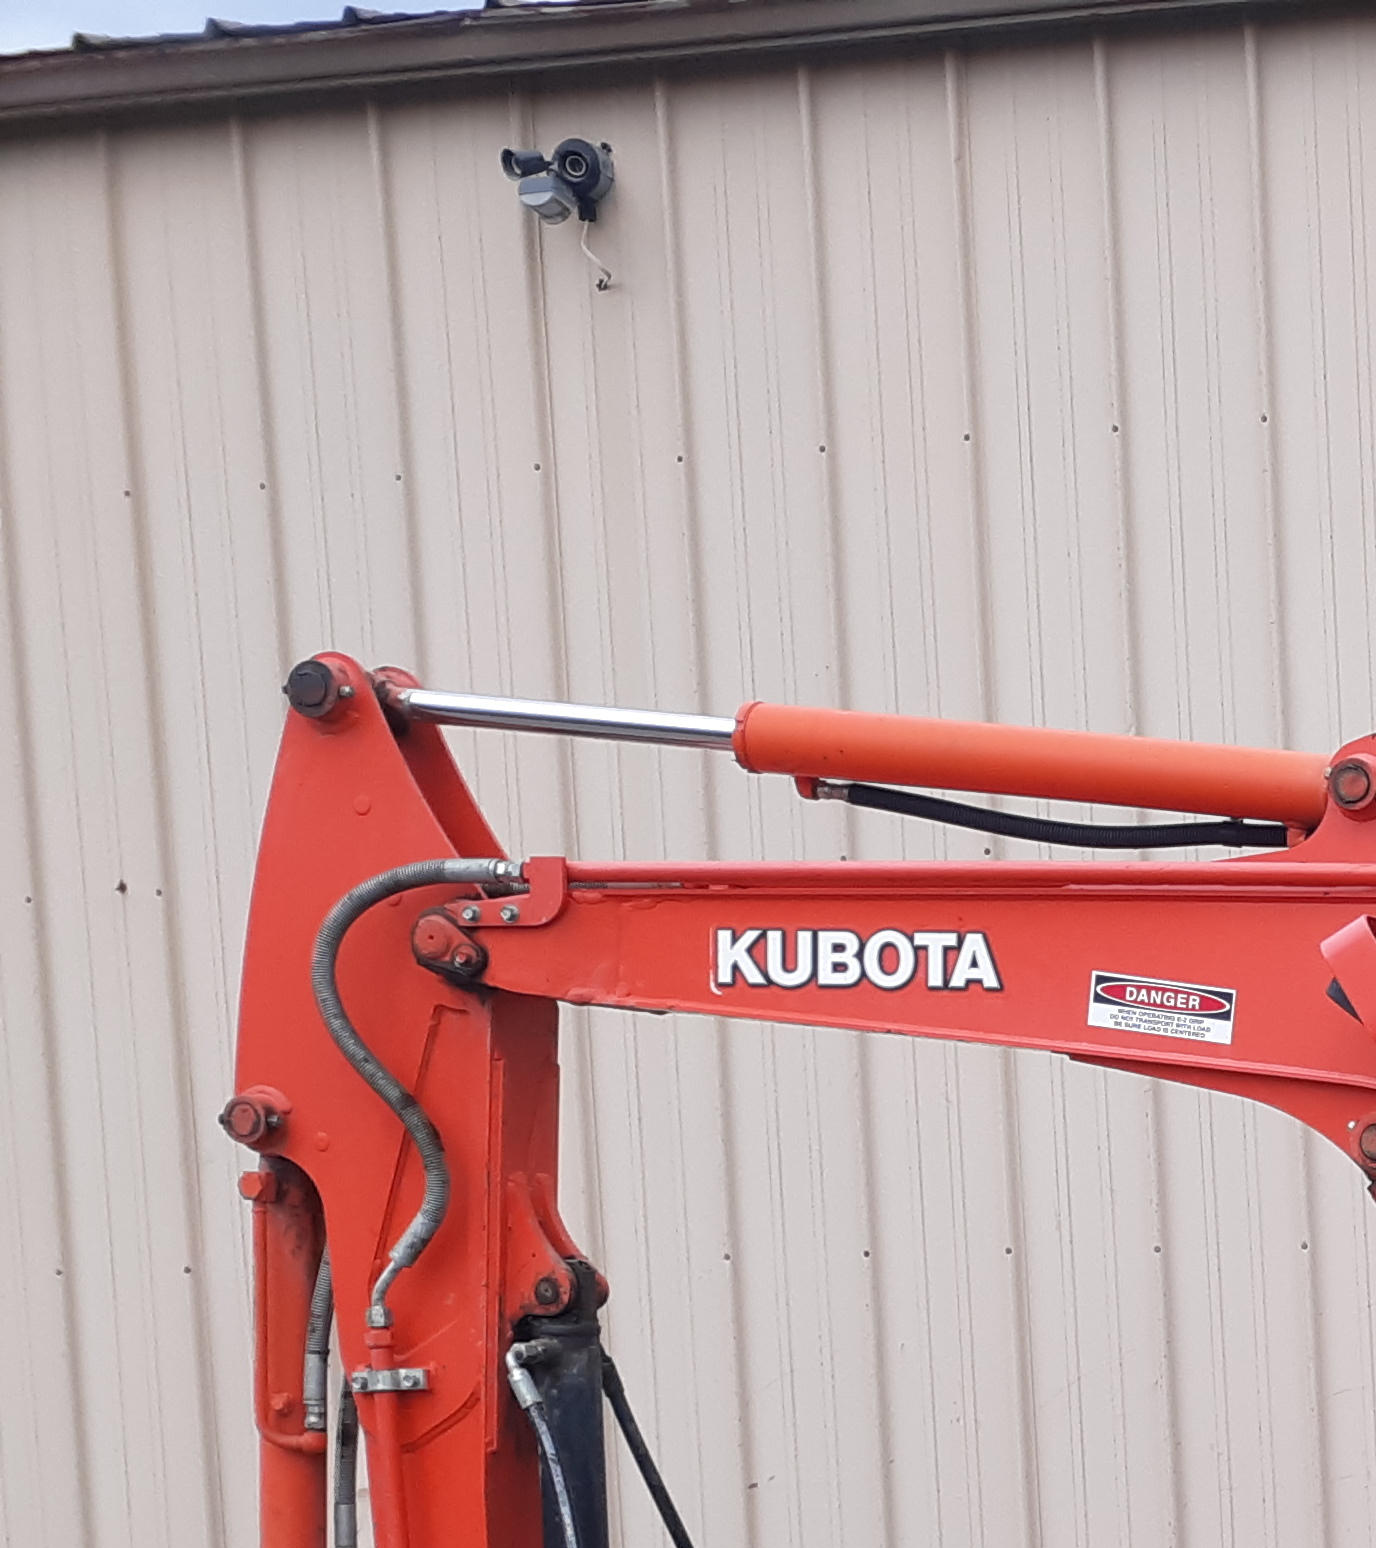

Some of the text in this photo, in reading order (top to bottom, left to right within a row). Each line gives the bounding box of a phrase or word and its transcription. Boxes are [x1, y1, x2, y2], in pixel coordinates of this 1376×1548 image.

[716, 929, 1003, 990] KUBOTA
[1125, 986, 1200, 1010] DANGER
[1135, 1016, 1174, 1028] TRANSPORT
[1192, 1024, 1211, 1033] LOAD
[1143, 1024, 1161, 1033] LOAD
[1170, 1028, 1206, 1038] CENTERED
